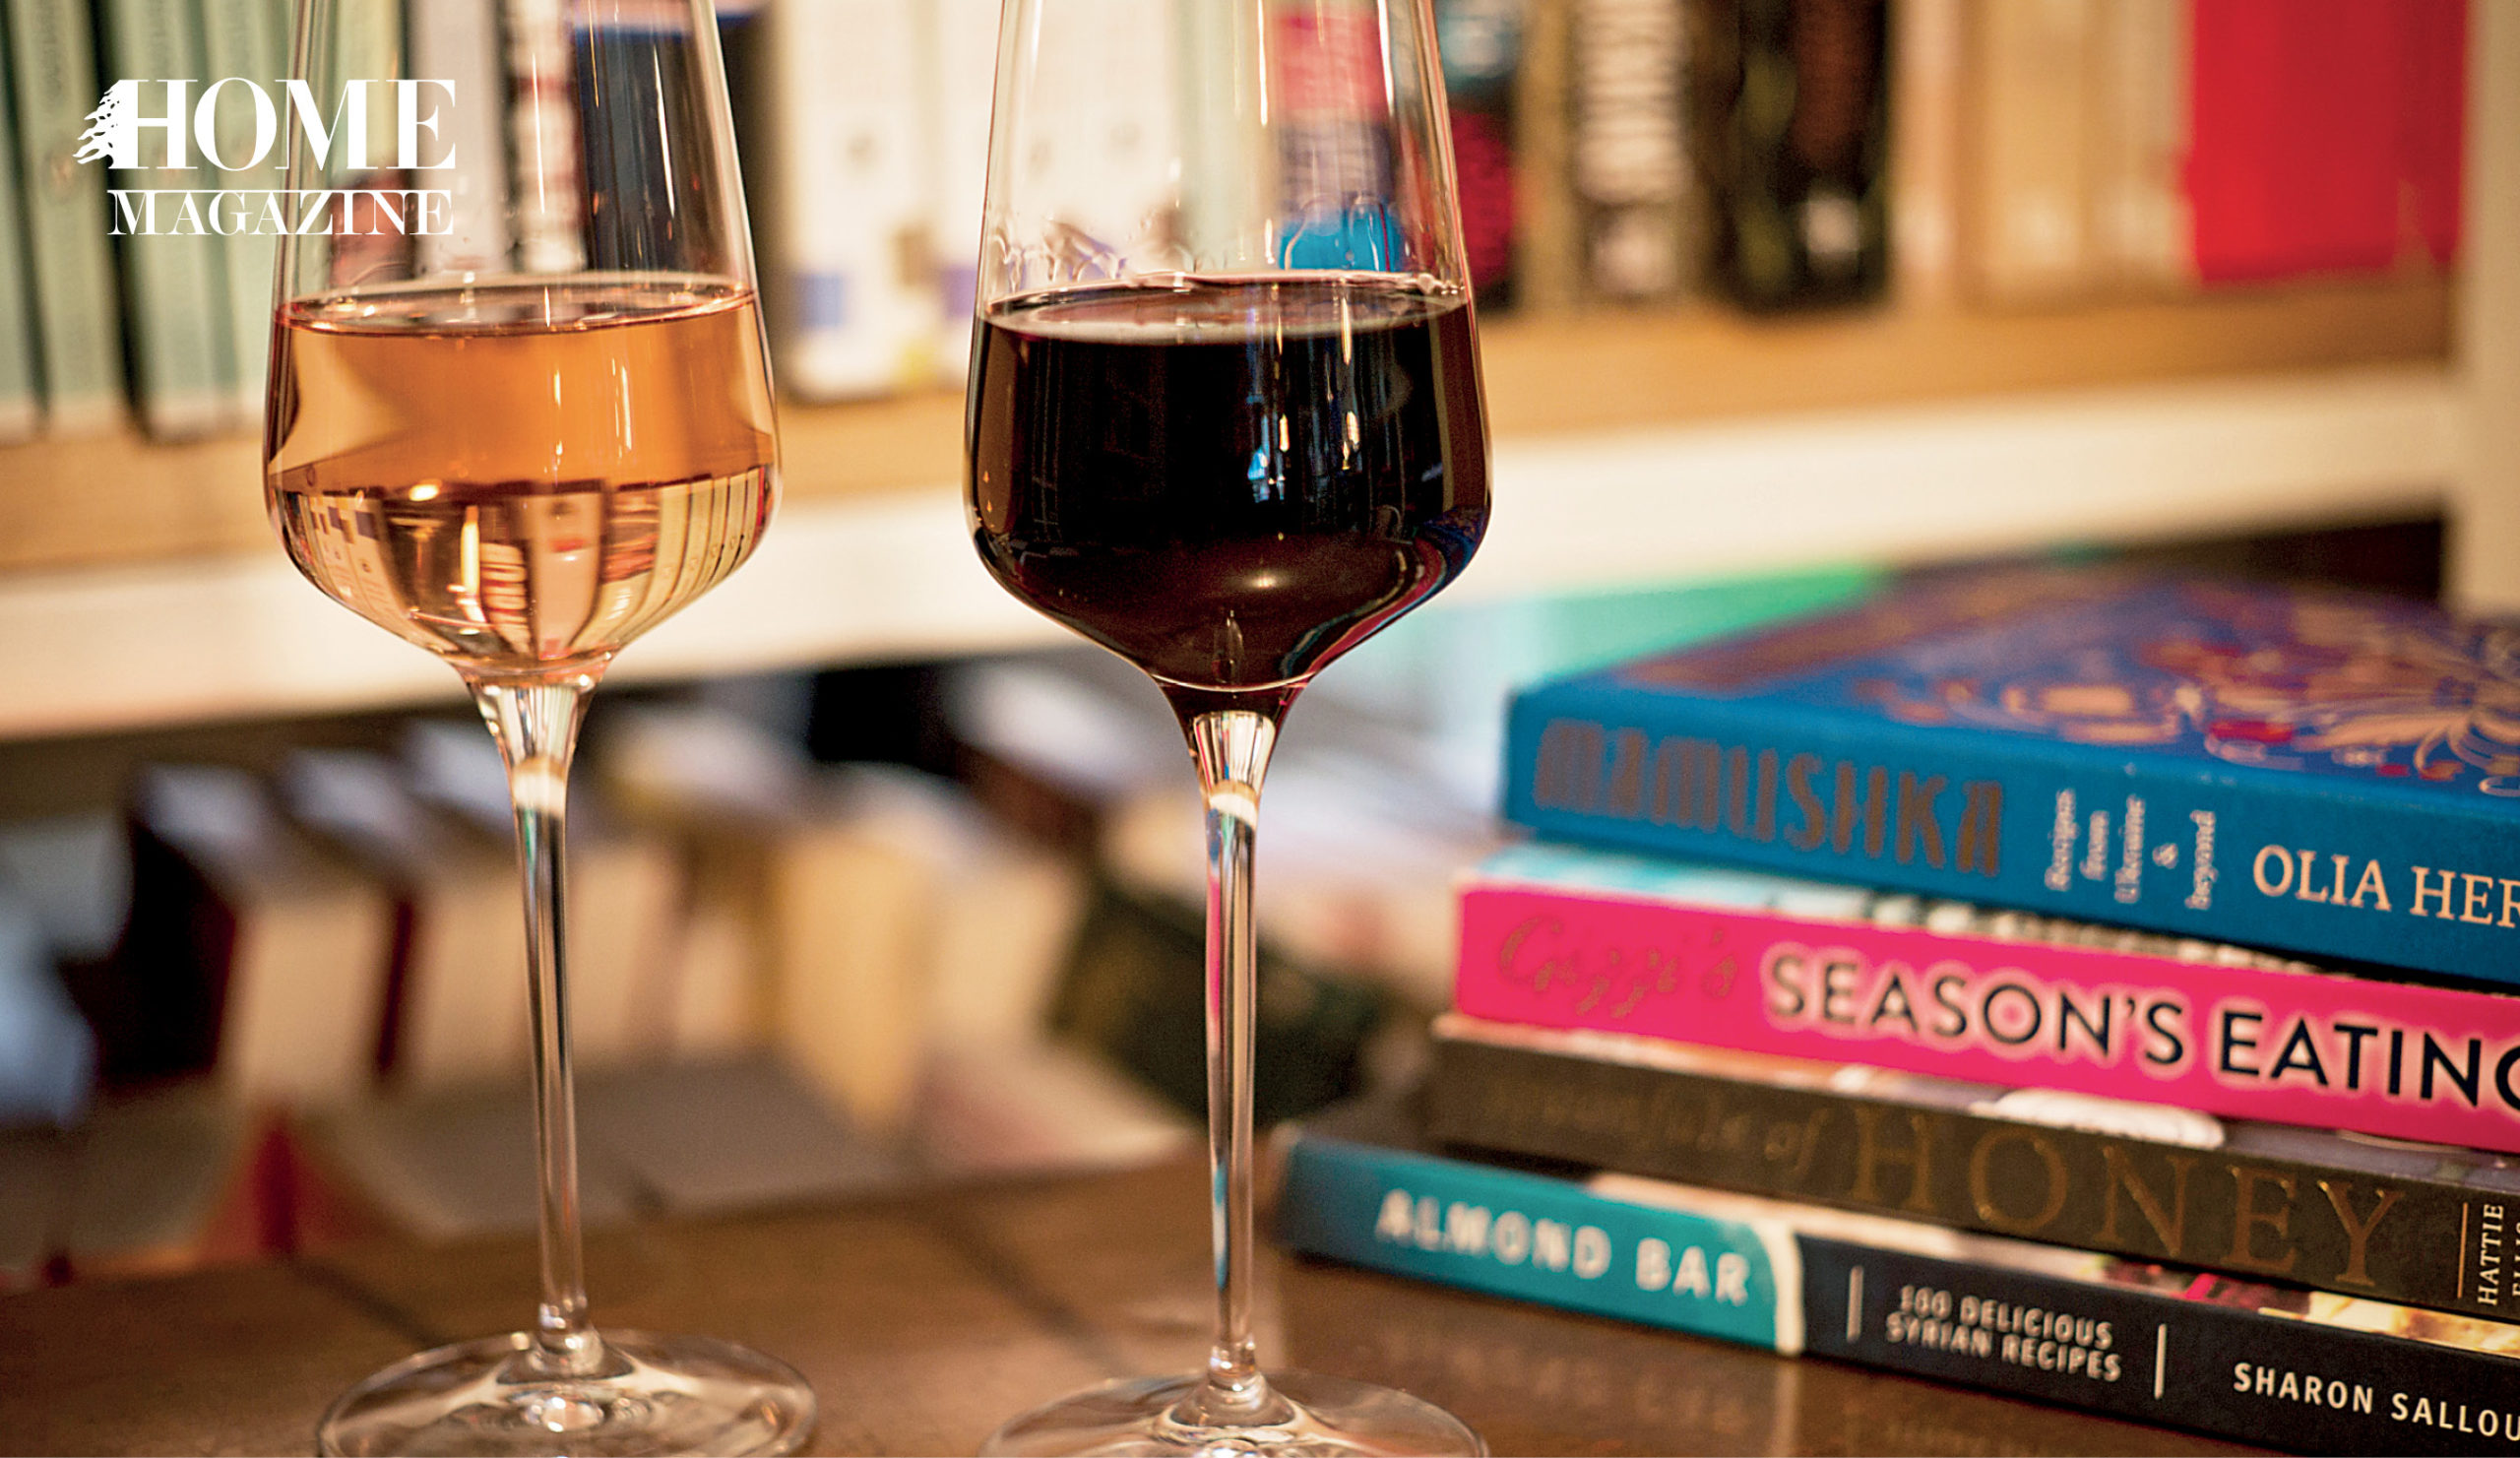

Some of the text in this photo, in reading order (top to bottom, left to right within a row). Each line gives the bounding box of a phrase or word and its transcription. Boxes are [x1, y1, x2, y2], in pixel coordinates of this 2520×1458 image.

[1533, 718, 2003, 878] MAMUSHKA
[2253, 844, 2392, 912] OLIA
[1854, 1103, 2406, 1288] HONEY
[1378, 1189, 1750, 1305] ALMOND BAR
[2477, 1204, 2504, 1306] HATTIE
[1886, 1311, 2122, 1382] SYRIAN RECIPES
[1901, 1285, 2112, 1351] 100 DELICIOUS
[2234, 1363, 2373, 1415] SHARON
